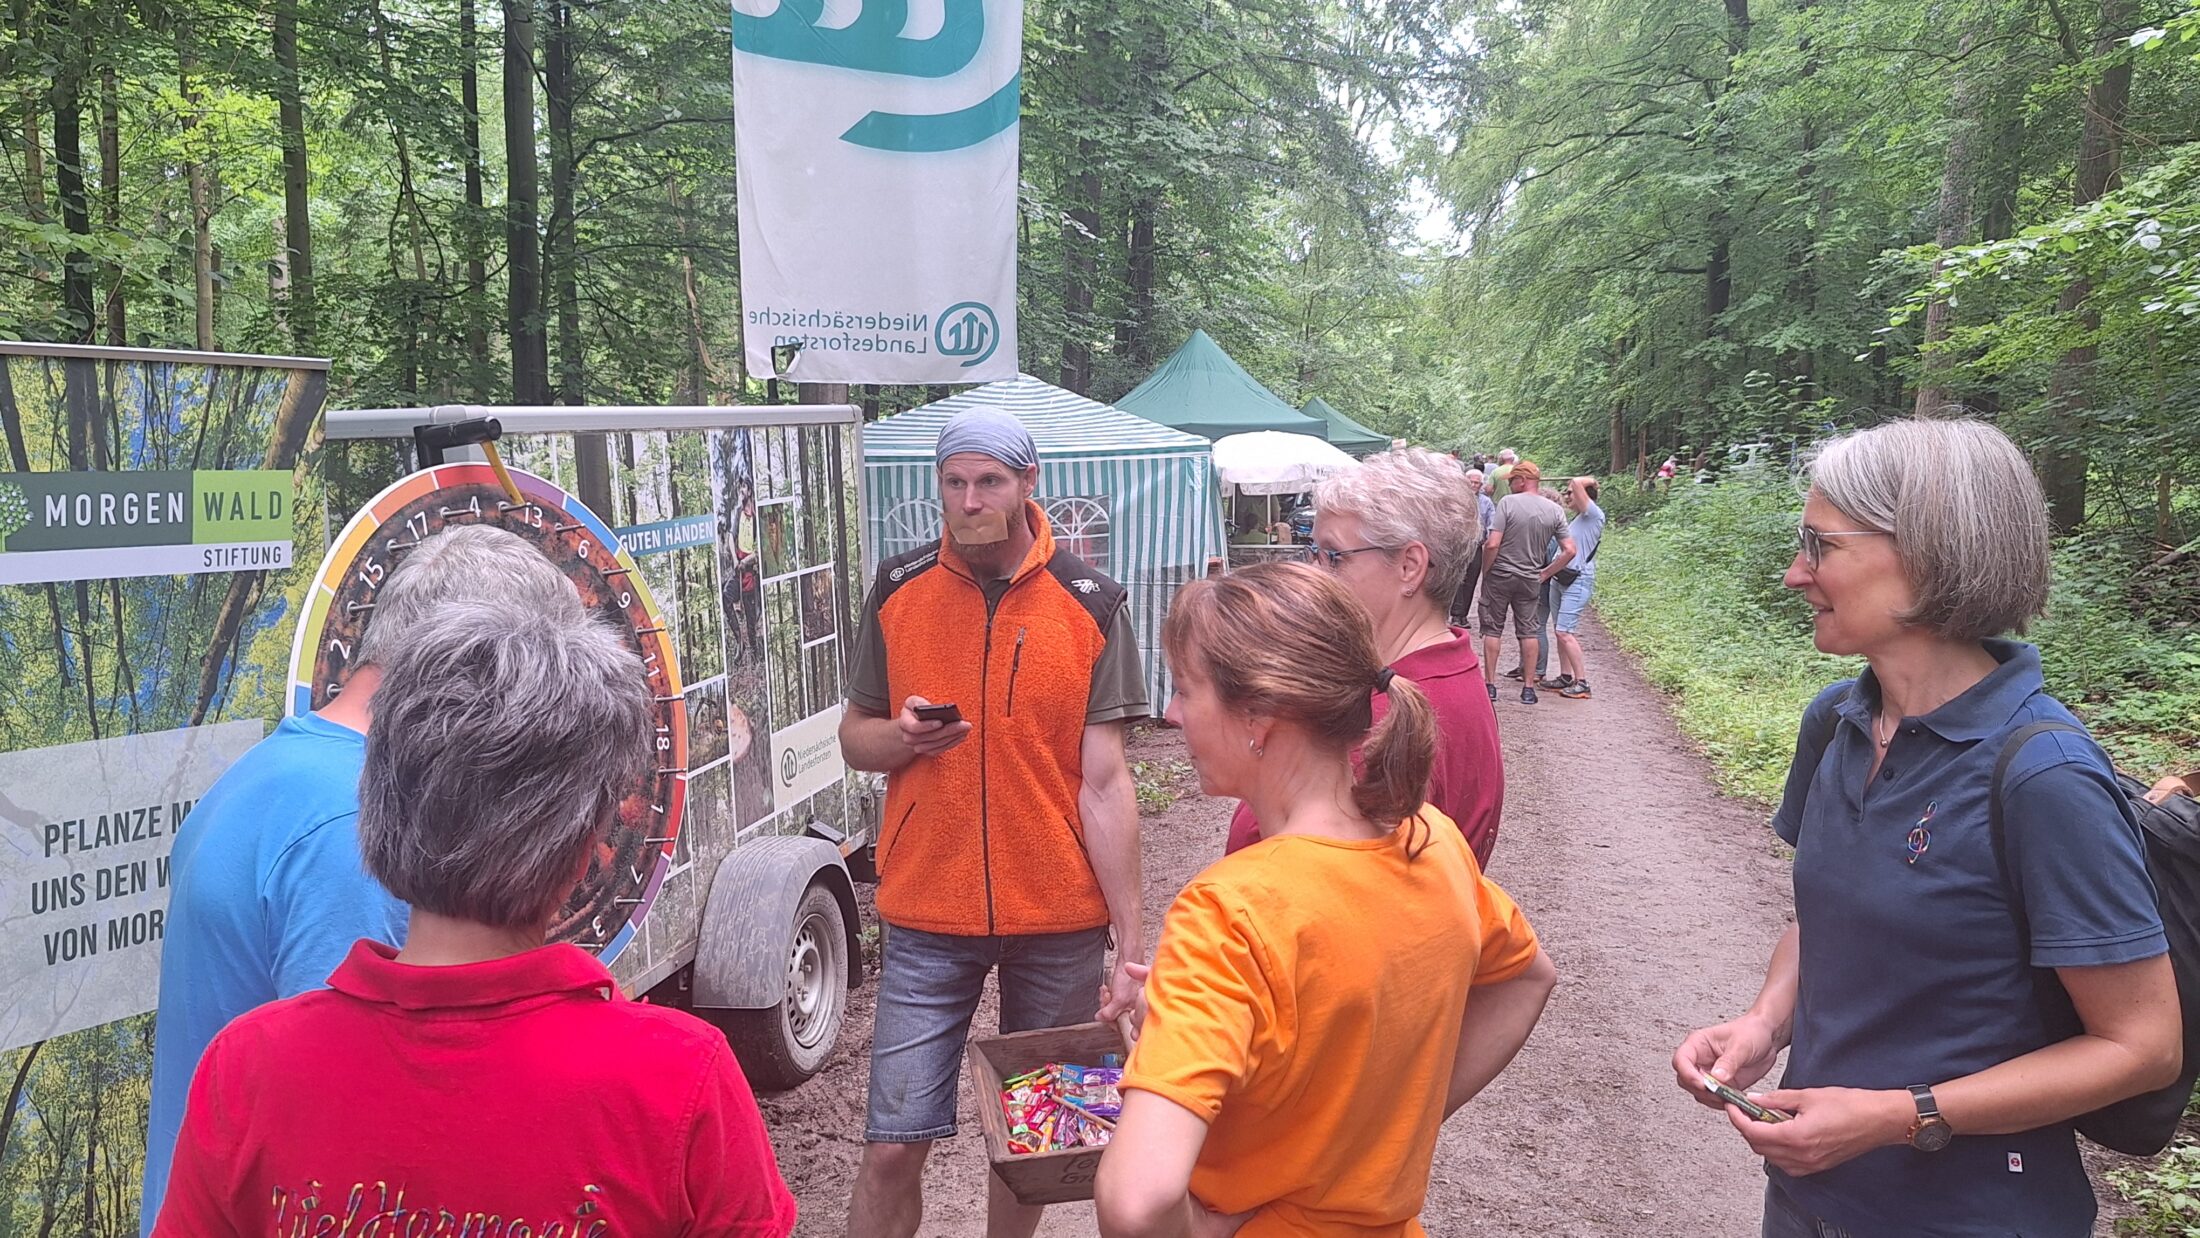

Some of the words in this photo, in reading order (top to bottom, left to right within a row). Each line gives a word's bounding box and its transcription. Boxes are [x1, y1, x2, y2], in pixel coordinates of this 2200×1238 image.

[45, 491, 184, 528] MORGEN
[203, 490, 282, 522] WALD
[469, 495, 481, 518] 4
[524, 506, 543, 528] 13
[406, 510, 429, 540] 17
[619, 529, 661, 552] GUTEN
[664, 521, 713, 546] HÄNDEN
[203, 546, 282, 567] STIFTUNG
[577, 540, 590, 559] 6
[359, 556, 384, 590] 15
[330, 639, 351, 660] 2
[643, 652, 660, 677] 11
[655, 724, 670, 750] 18
[44, 805, 163, 858] PFLANZE
[171, 799, 199, 834] M
[31, 872, 86, 915] UNS
[96, 860, 147, 901] DEN
[43, 923, 97, 966] VON
[108, 909, 164, 952] MOR
[592, 915, 606, 938] 3
